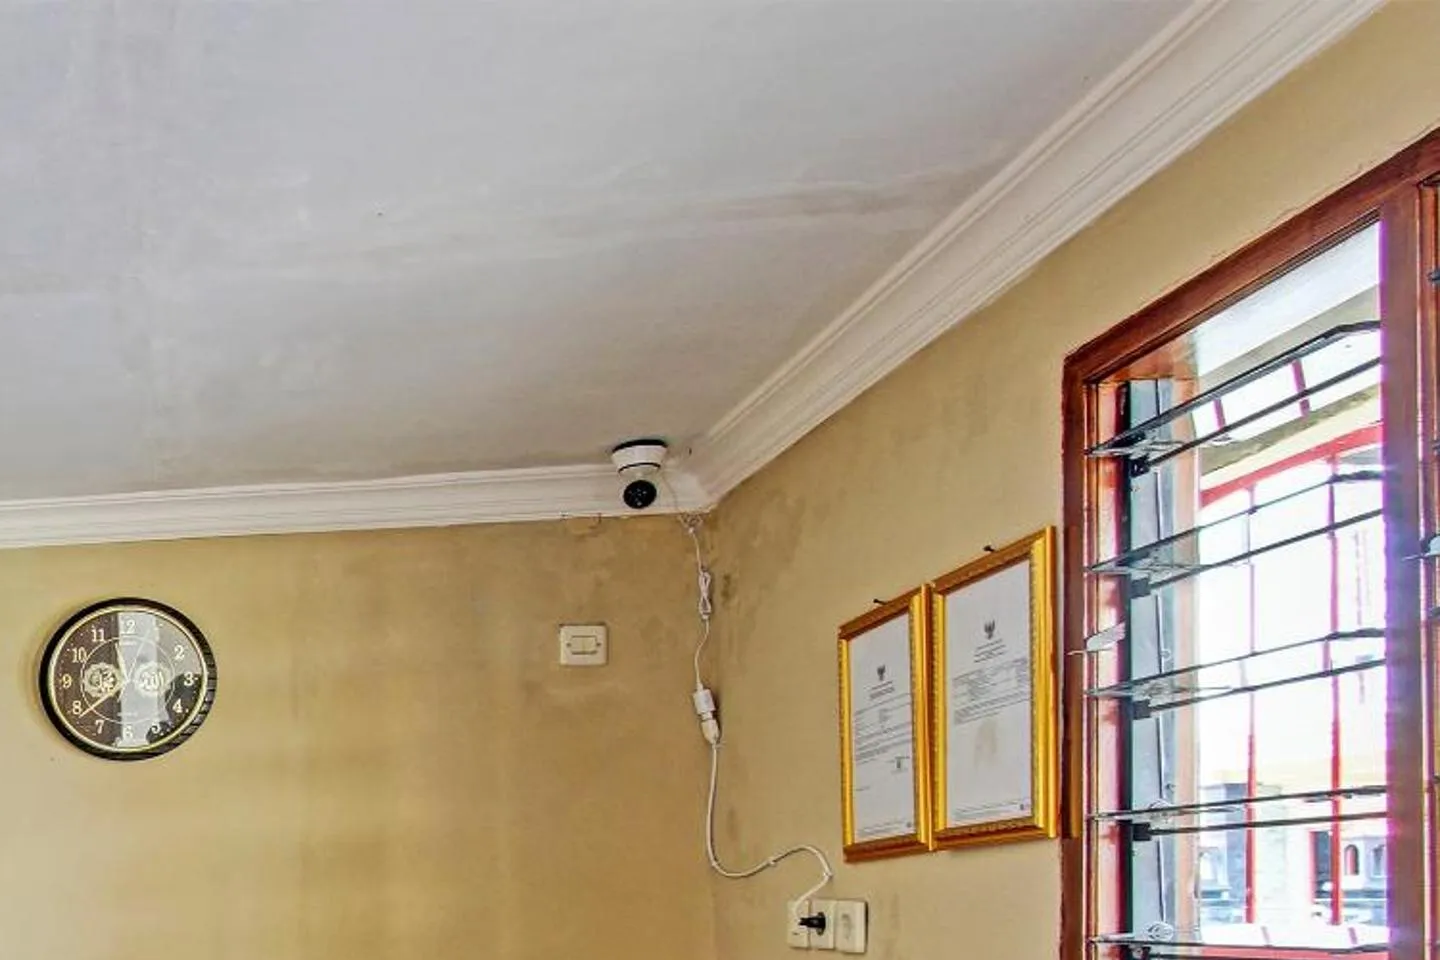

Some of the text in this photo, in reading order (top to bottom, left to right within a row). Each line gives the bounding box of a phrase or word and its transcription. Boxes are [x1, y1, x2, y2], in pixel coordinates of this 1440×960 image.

[91, 628, 105, 643] 11
[72, 647, 87, 663] 10
[174, 645, 185, 660] 2
[62, 674, 73, 689] 9
[183, 672, 194, 686] 3
[72, 701, 82, 715] 8
[172, 699, 183, 713] 4
[95, 720, 105, 734] 7
